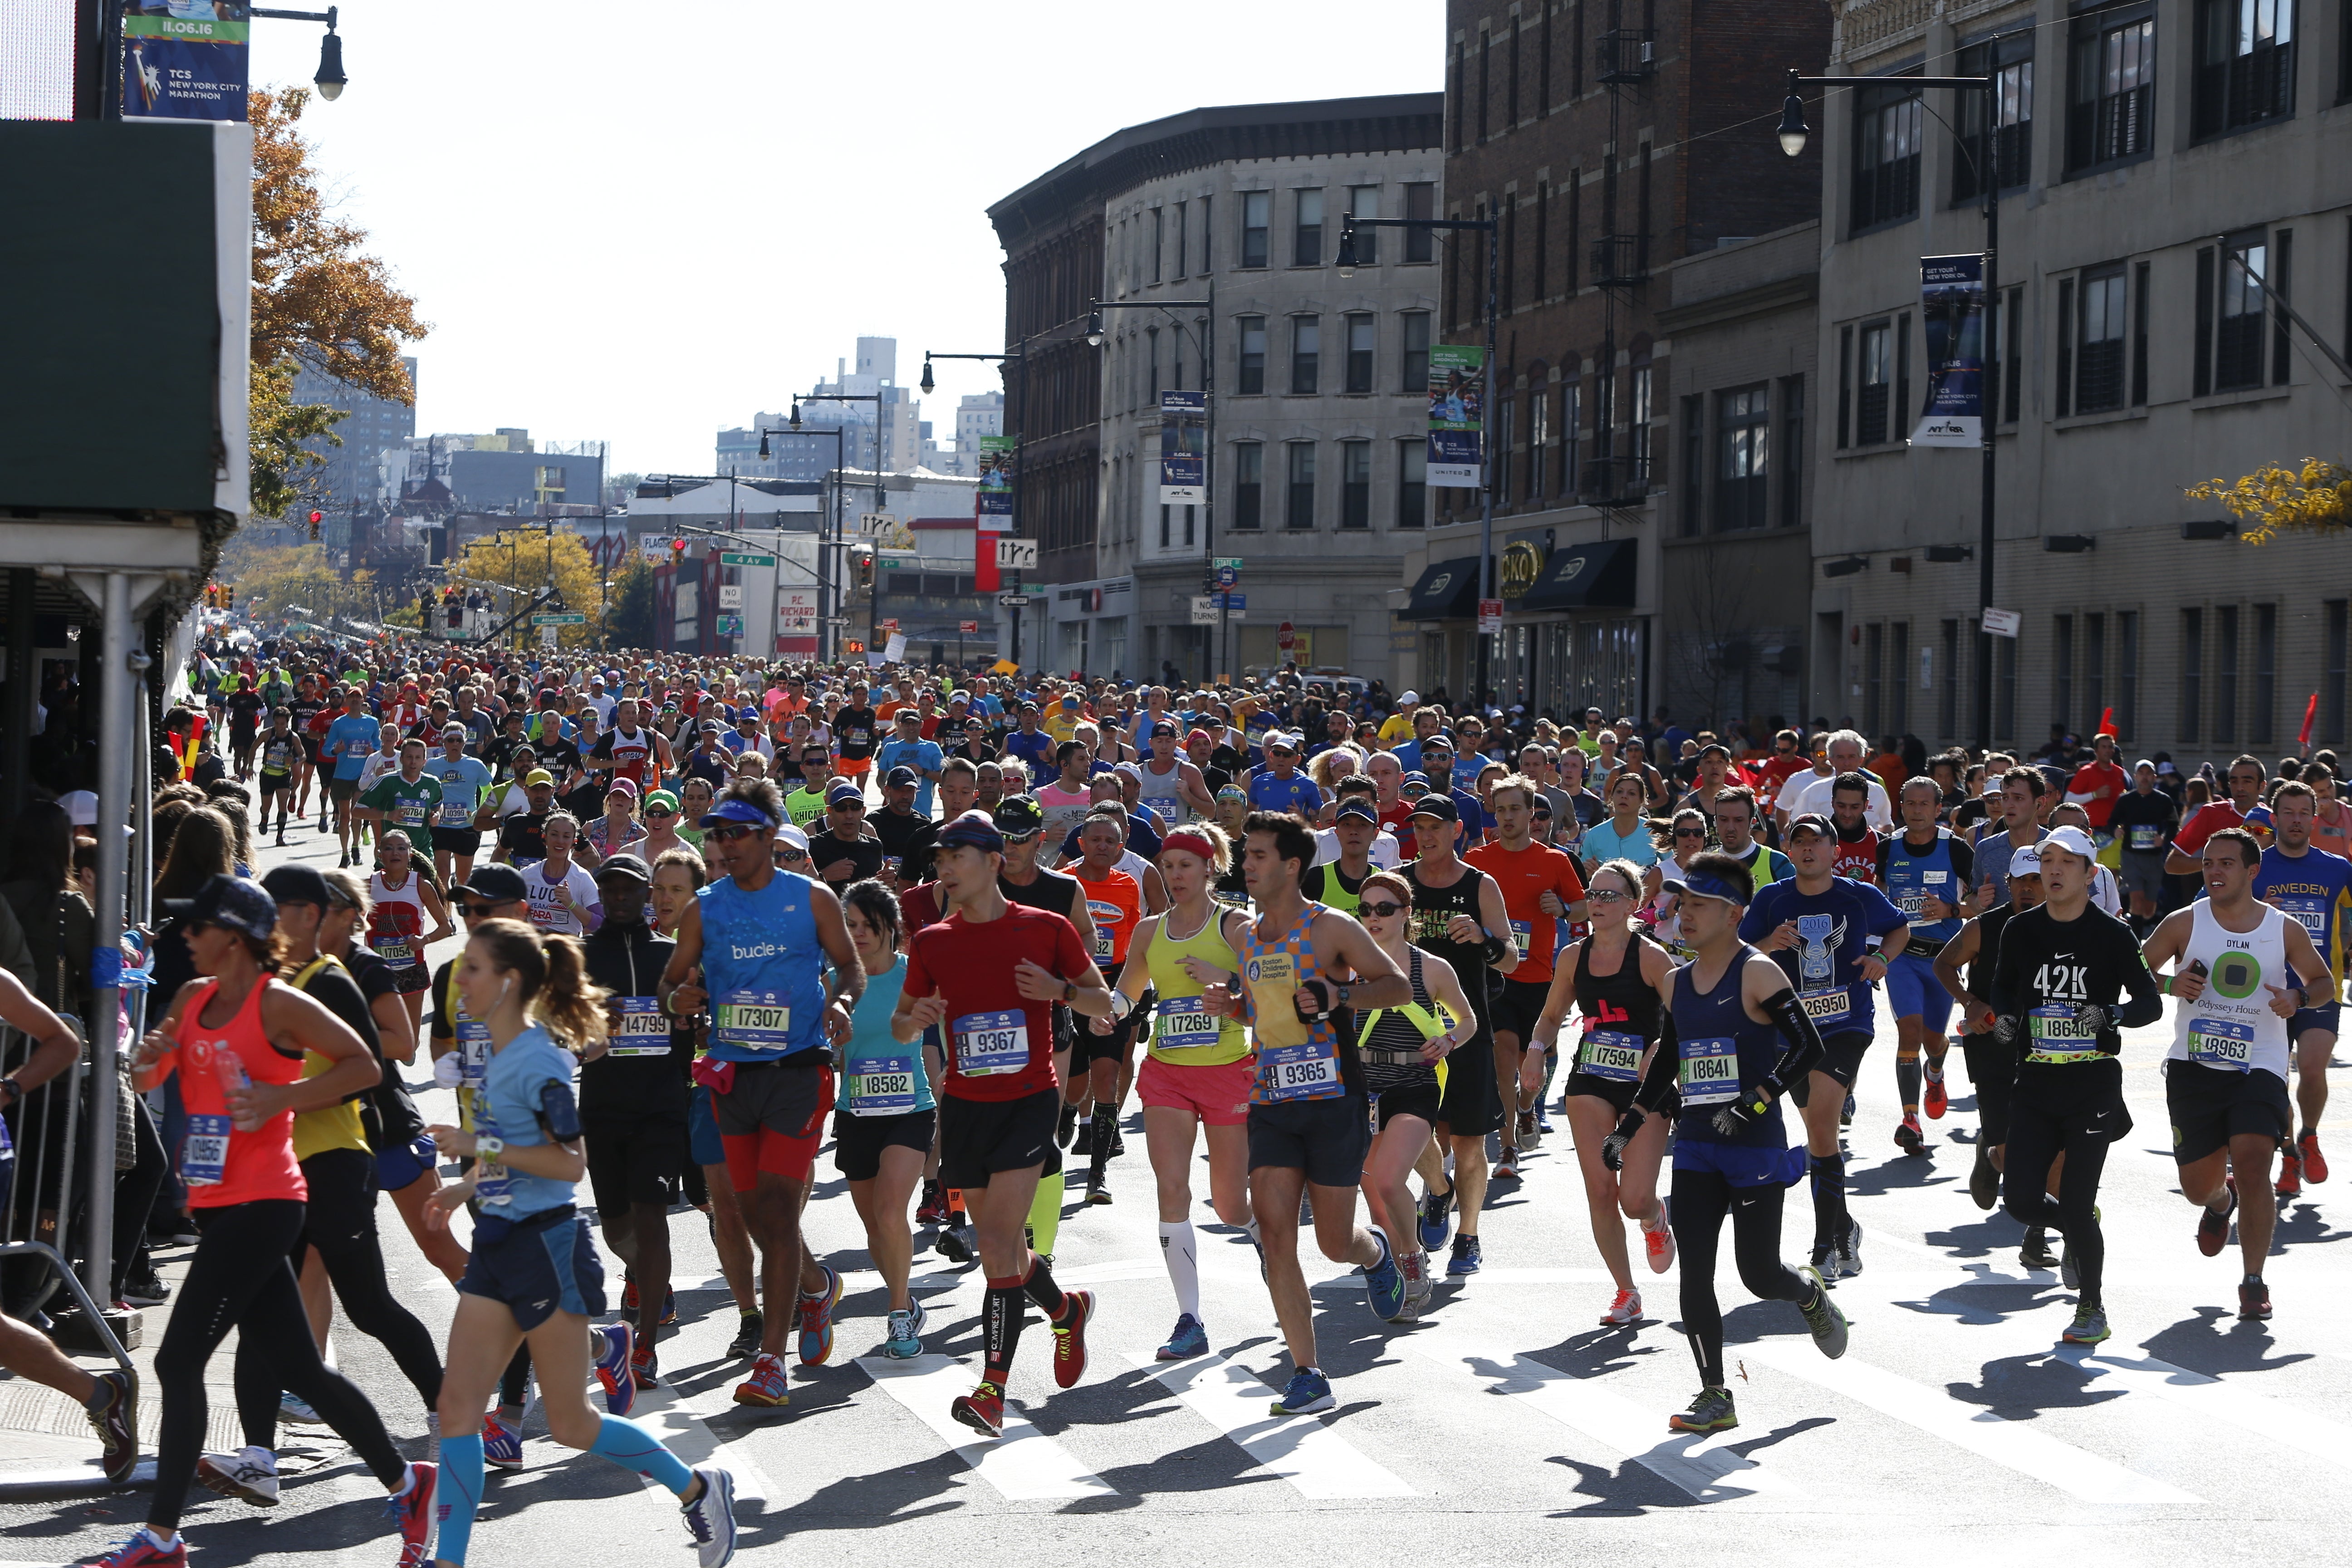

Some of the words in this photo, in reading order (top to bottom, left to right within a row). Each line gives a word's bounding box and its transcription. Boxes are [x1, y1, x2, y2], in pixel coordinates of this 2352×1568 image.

[163, 21, 212, 34] 11.06.16
[169, 69, 192, 79] TCS
[169, 80, 191, 88] NEW
[192, 81, 218, 90] YORK
[219, 83, 241, 91] CITY
[169, 90, 220, 100] MARATHON
[1216, 559, 1233, 568] STATE
[1501, 554, 1529, 583] CKO
[780, 607, 815, 616] RICHARD
[793, 617, 810, 627] SN
[1279, 631, 1294, 642] STOP
[530, 885, 559, 903] LUC
[2268, 882, 2329, 897] SWEDEN
[1802, 919, 1828, 930] 2016
[2226, 939, 2250, 949] DYLAN
[385, 946, 411, 958] 17054
[1261, 964, 1291, 972] Children's
[1262, 971, 1288, 980] Hospital
[2033, 964, 2088, 1000] 42K
[1805, 995, 1847, 1015] 26950
[2198, 998, 2233, 1014] Odyssey
[2235, 1004, 2261, 1015] House
[738, 1008, 782, 1028] 17307
[1172, 1014, 1212, 1033] 17269
[626, 1015, 666, 1034] 14799
[2201, 1024, 2227, 1033] CONSULTANCY
[978, 1031, 1017, 1053] 9367
[963, 1046, 968, 1056] E
[1596, 1047, 1636, 1068] 17594
[1285, 1061, 1326, 1084] 9365
[1693, 1058, 1729, 1079] 18641
[866, 1075, 908, 1094] 18582
[1272, 1077, 1278, 1088] E
